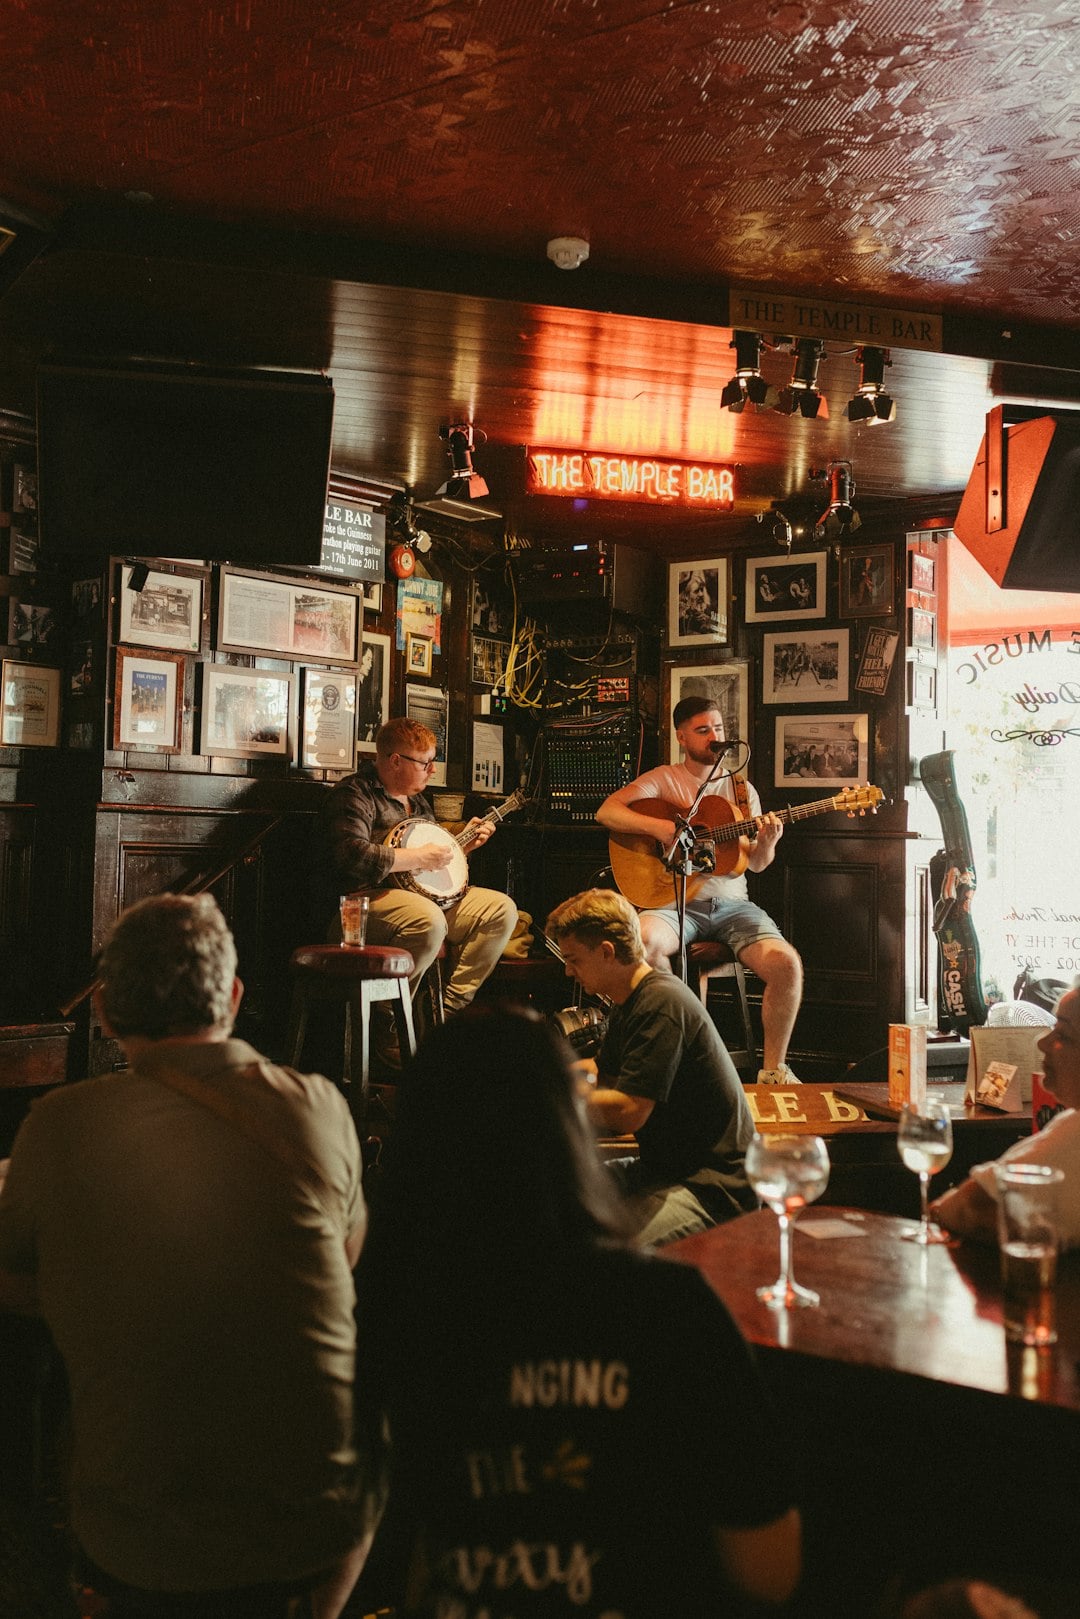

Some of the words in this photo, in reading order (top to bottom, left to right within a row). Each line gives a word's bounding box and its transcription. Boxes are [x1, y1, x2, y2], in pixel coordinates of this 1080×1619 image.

[740, 299, 785, 323] THE
[794, 304, 882, 336] TEMPLE
[891, 317, 933, 342] BAR
[534, 454, 584, 488] THE
[590, 457, 683, 497] TEMPLE
[688, 466, 734, 502] BAR
[344, 509, 373, 528] BAR
[336, 524, 346, 536] the
[347, 526, 373, 541] Guinness
[343, 540, 364, 555] playing
[364, 544, 382, 556] guitar
[331, 551, 346, 565] 17th
[347, 554, 363, 568] June
[363, 558, 379, 571] 2011
[948, 970, 968, 1016] CASH
